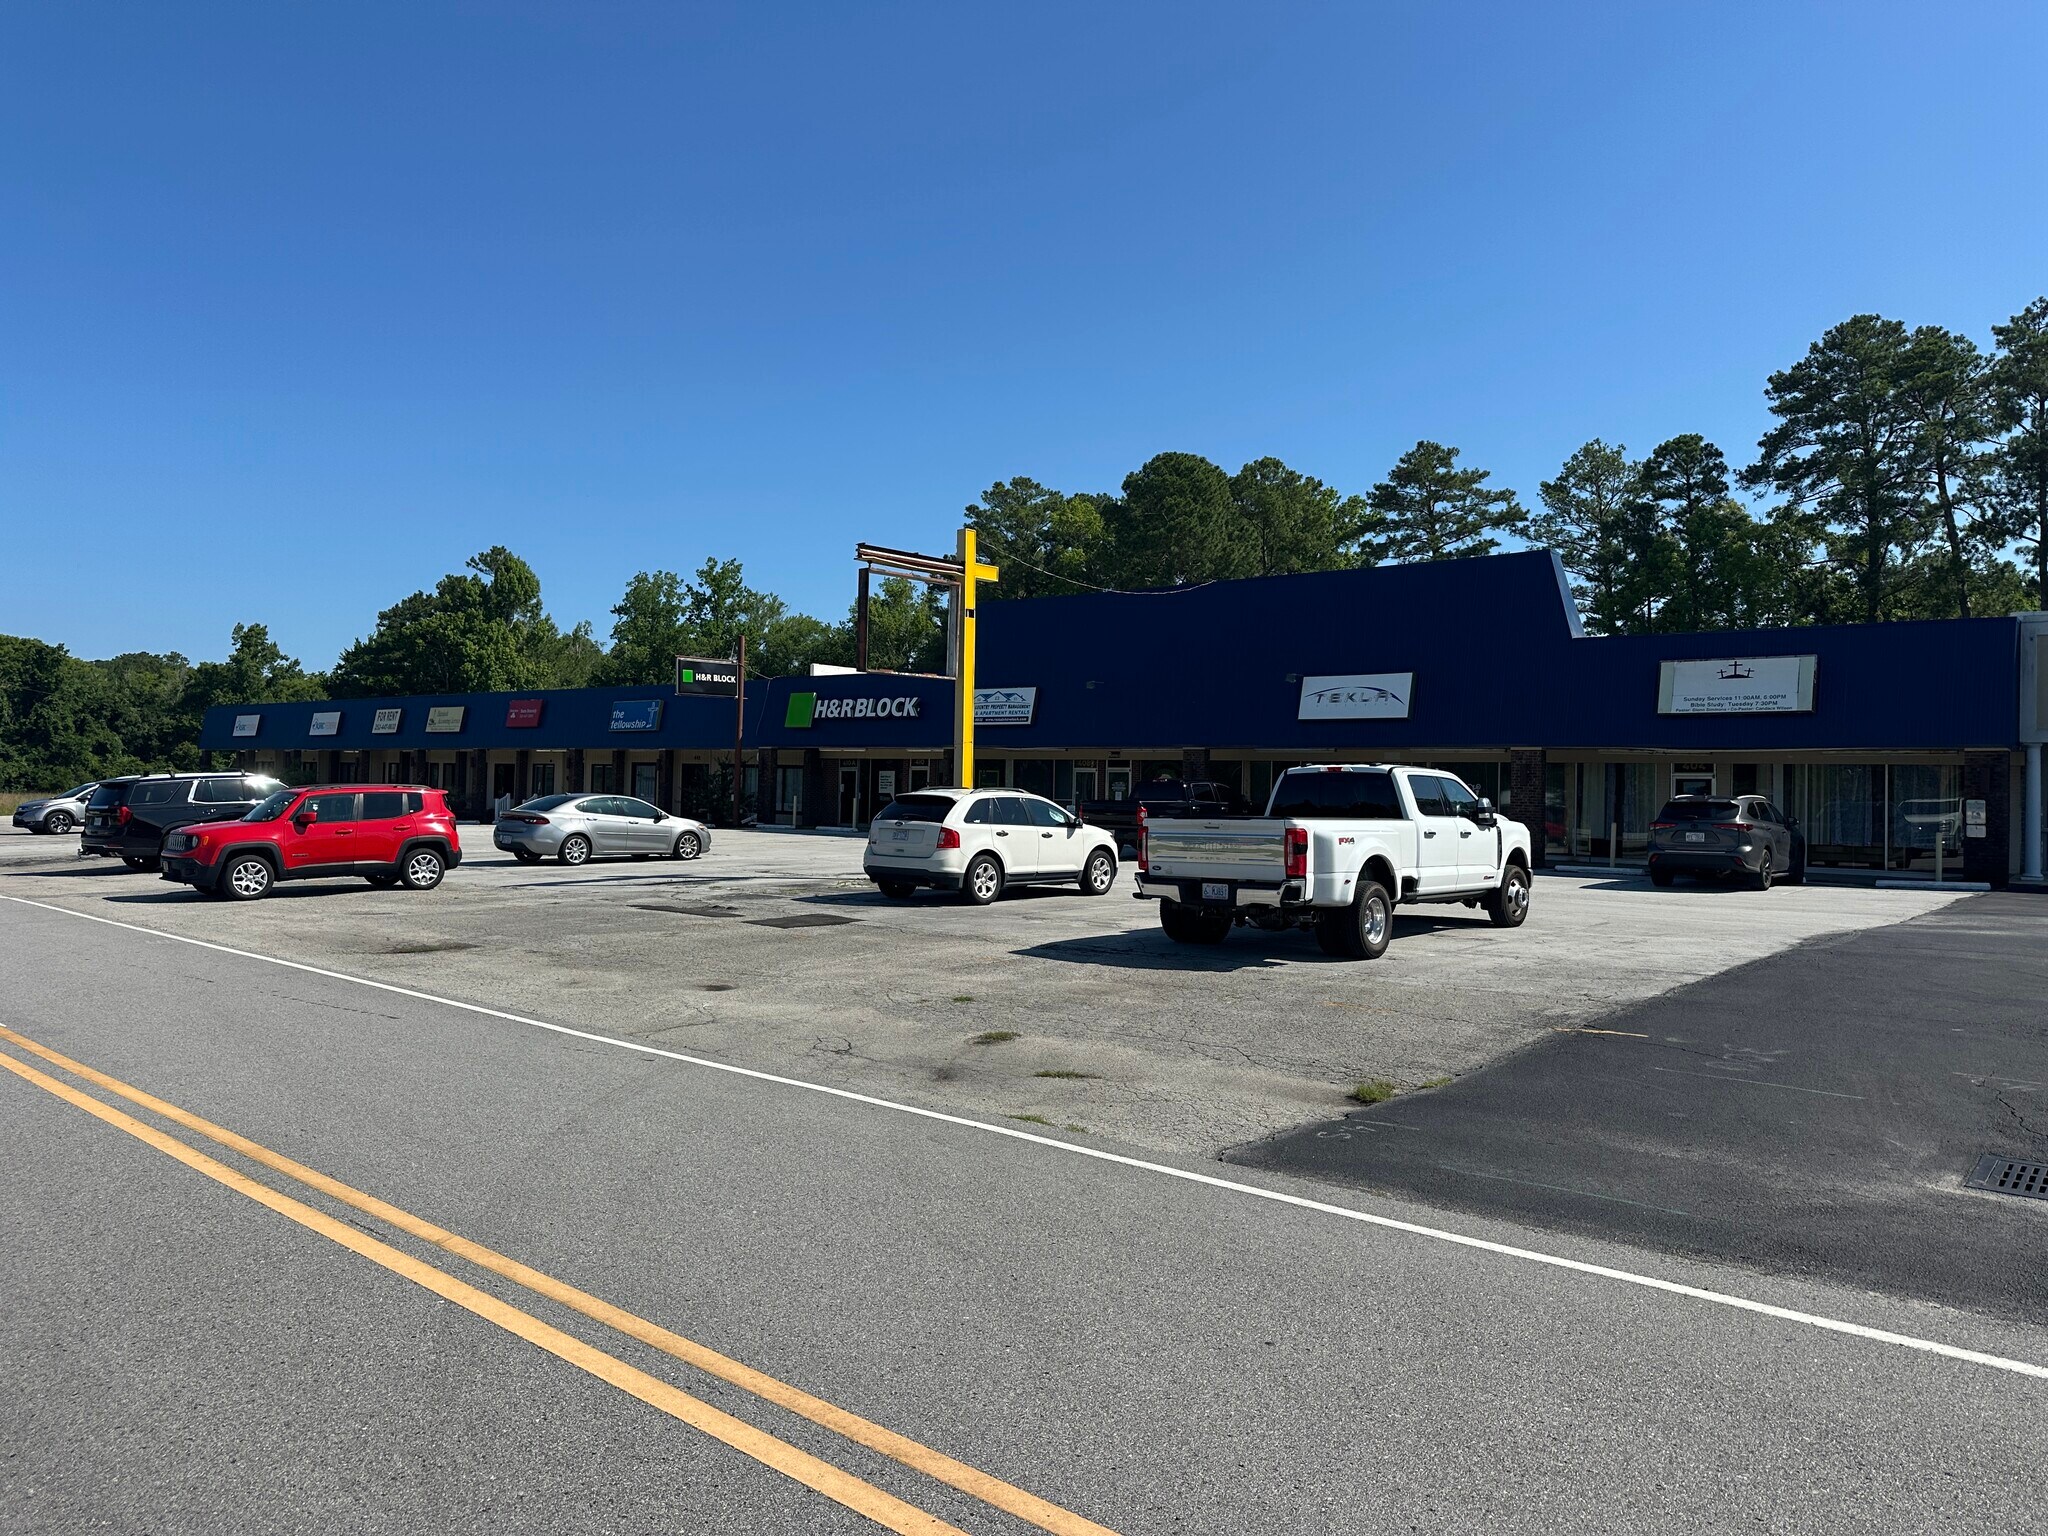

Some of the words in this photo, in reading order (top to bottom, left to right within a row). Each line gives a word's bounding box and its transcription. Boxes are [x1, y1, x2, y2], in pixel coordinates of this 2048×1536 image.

[696, 673, 712, 682] H&R
[713, 674, 737, 683] BLOCK
[1315, 691, 1389, 704] TEKLA
[377, 711, 387, 722] FOR
[386, 710, 399, 721] RENT
[612, 710, 625, 719] the
[610, 720, 647, 730] fellowship
